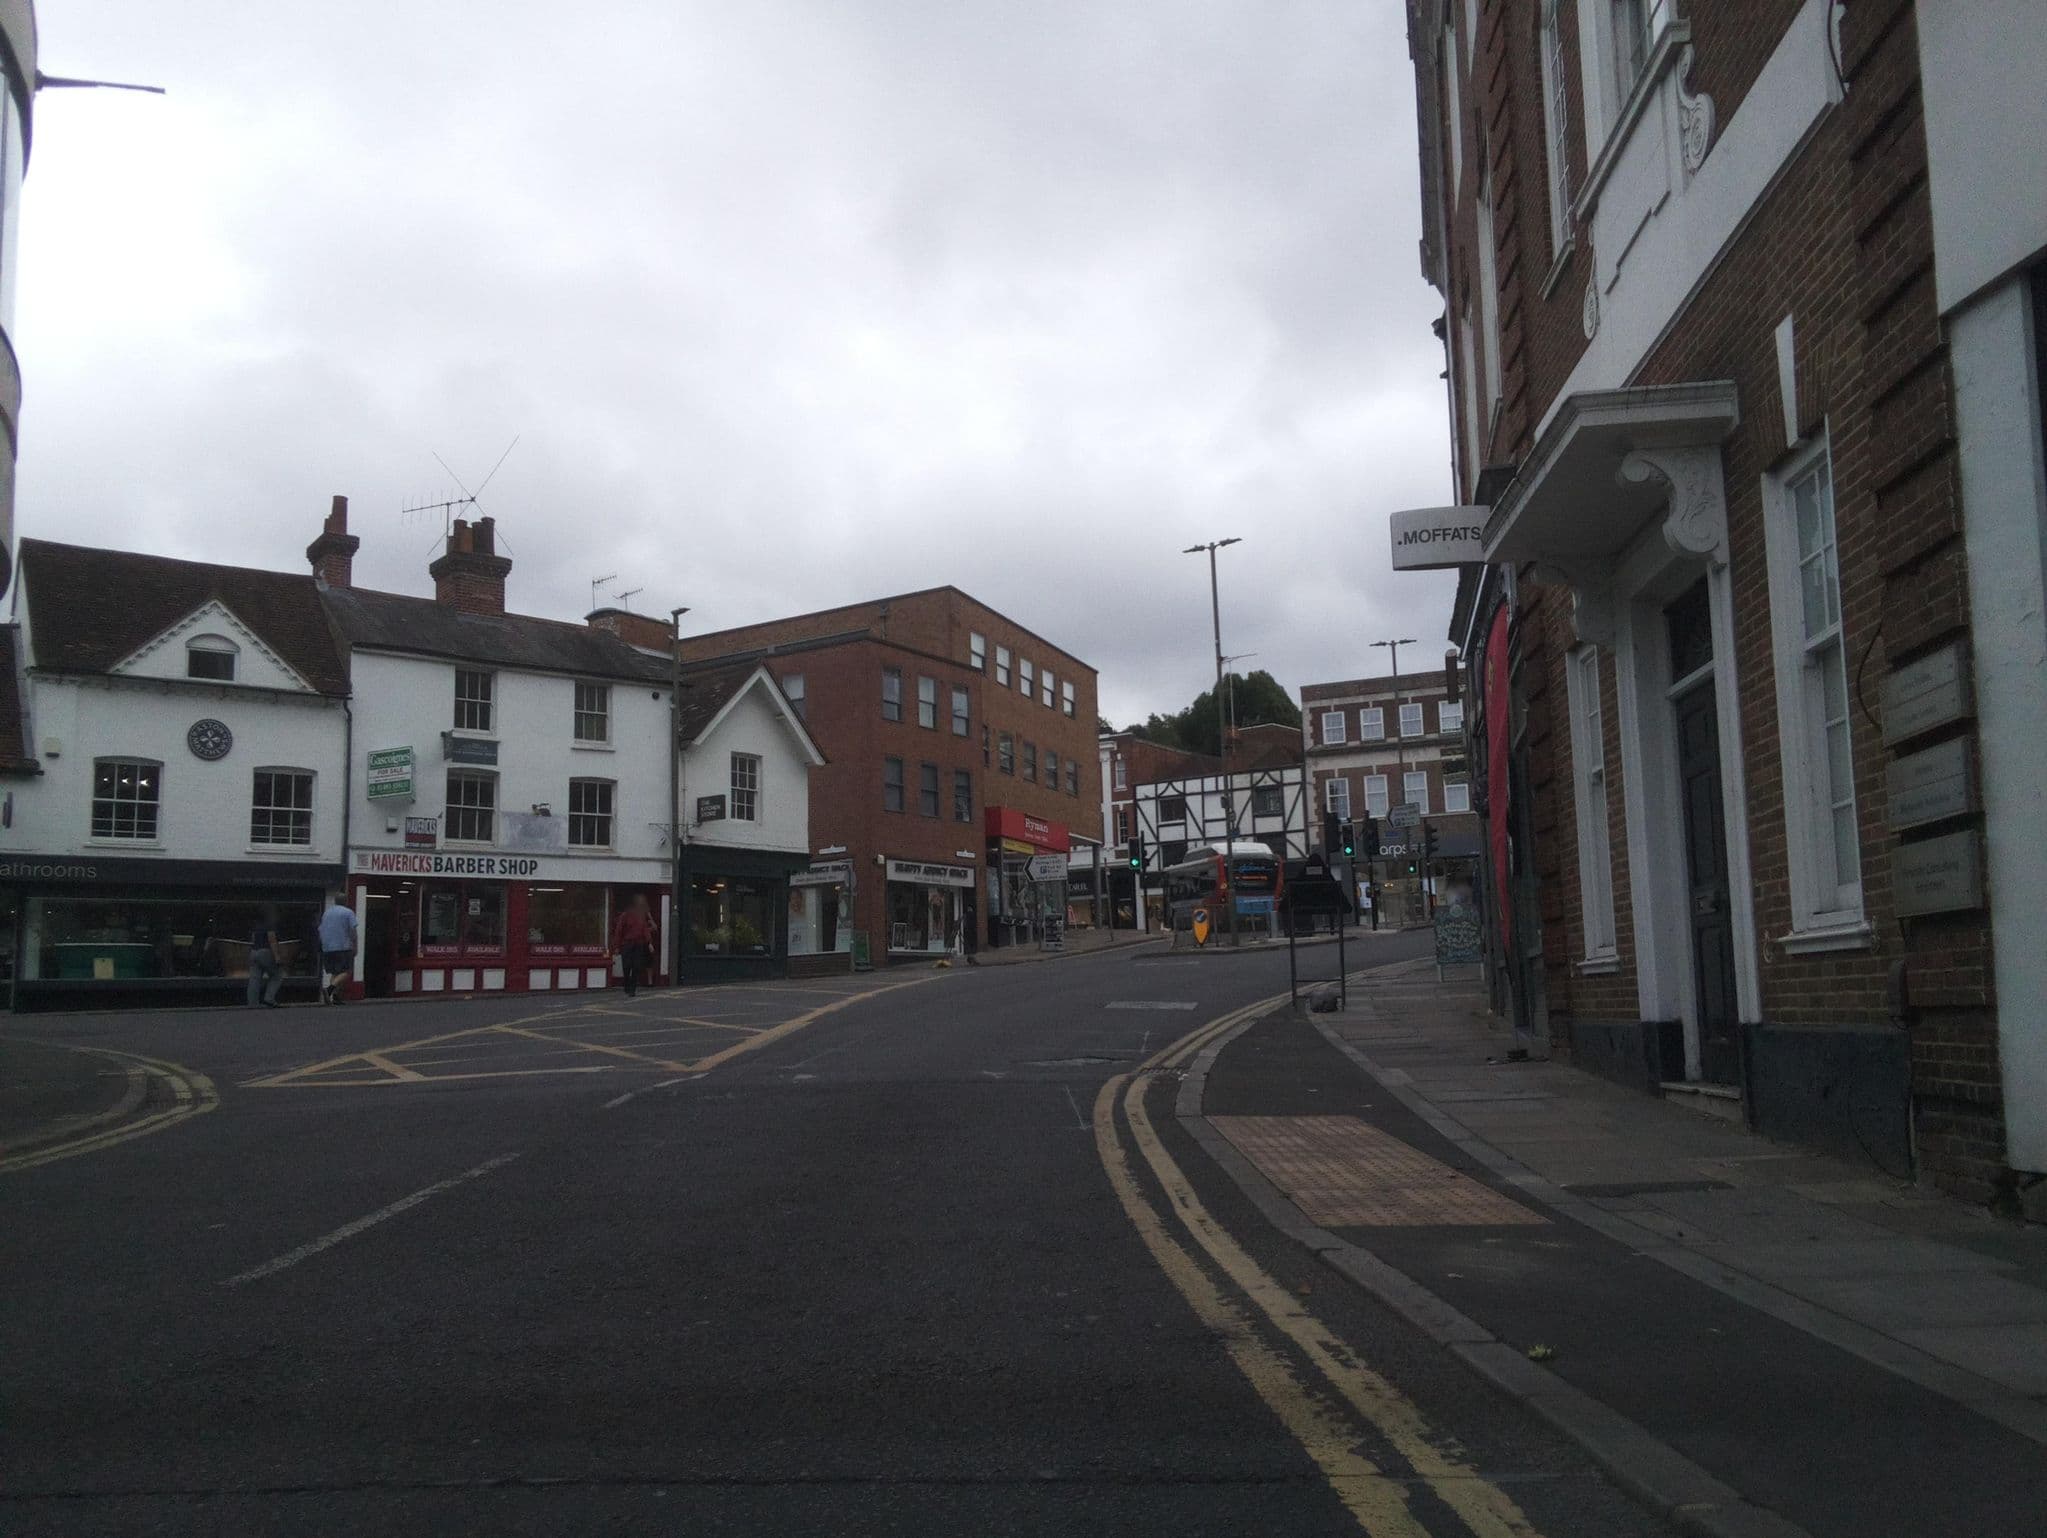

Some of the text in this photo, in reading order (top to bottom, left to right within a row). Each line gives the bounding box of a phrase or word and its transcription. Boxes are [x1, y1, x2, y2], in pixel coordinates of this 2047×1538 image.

[1025, 818, 1049, 834] Ryman
[1379, 844, 1407, 858] arps
[371, 853, 538, 875] MAVERICKS BARBER SHOP
[426, 945, 446, 953] WALK
[467, 945, 501, 953] AVAILABLE
[535, 945, 553, 953] WALK
[572, 945, 604, 953] AVAILABLE
